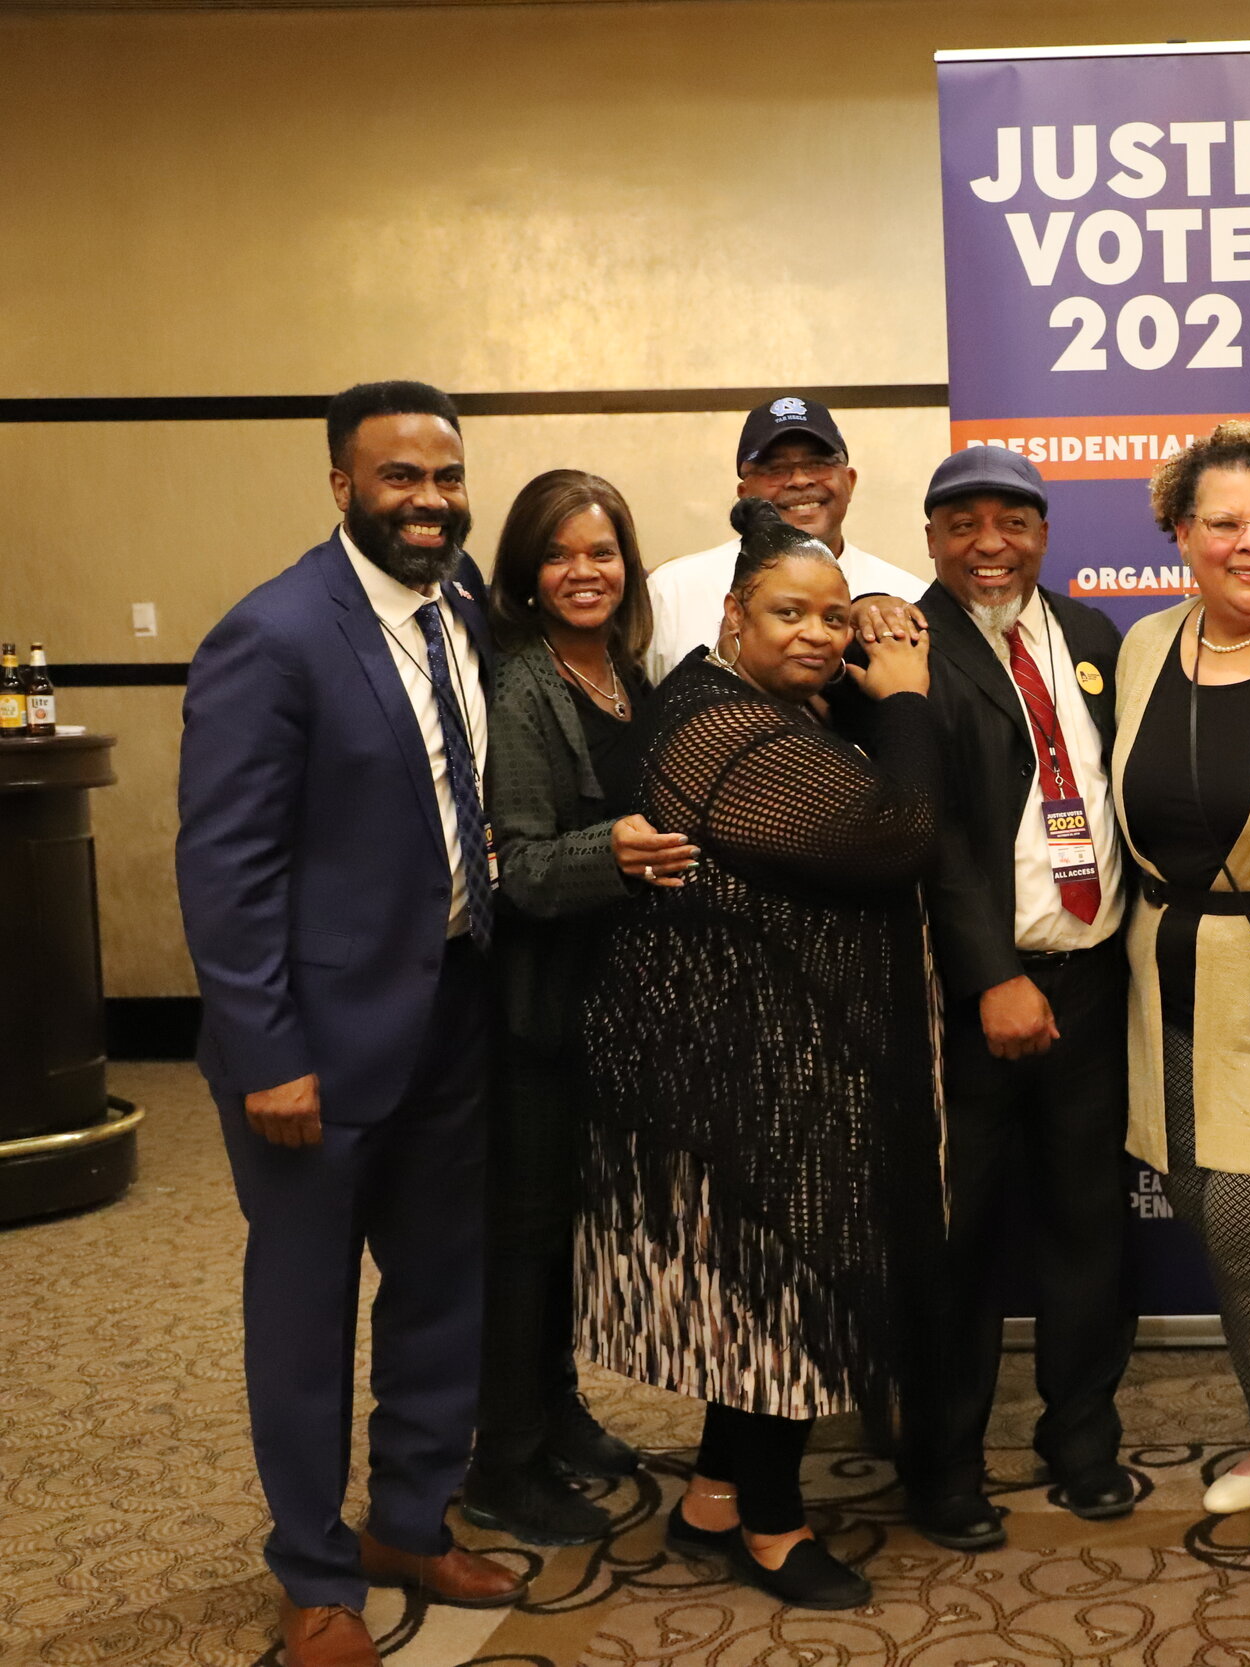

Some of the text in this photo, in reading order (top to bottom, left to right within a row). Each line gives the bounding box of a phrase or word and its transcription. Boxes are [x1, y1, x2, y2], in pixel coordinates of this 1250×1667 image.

[967, 434, 1194, 463] ESIDENTIA
[31, 698, 48, 708] Lite
[1048, 815, 1085, 831] 2020
[1069, 868, 1095, 876] ACCESS
